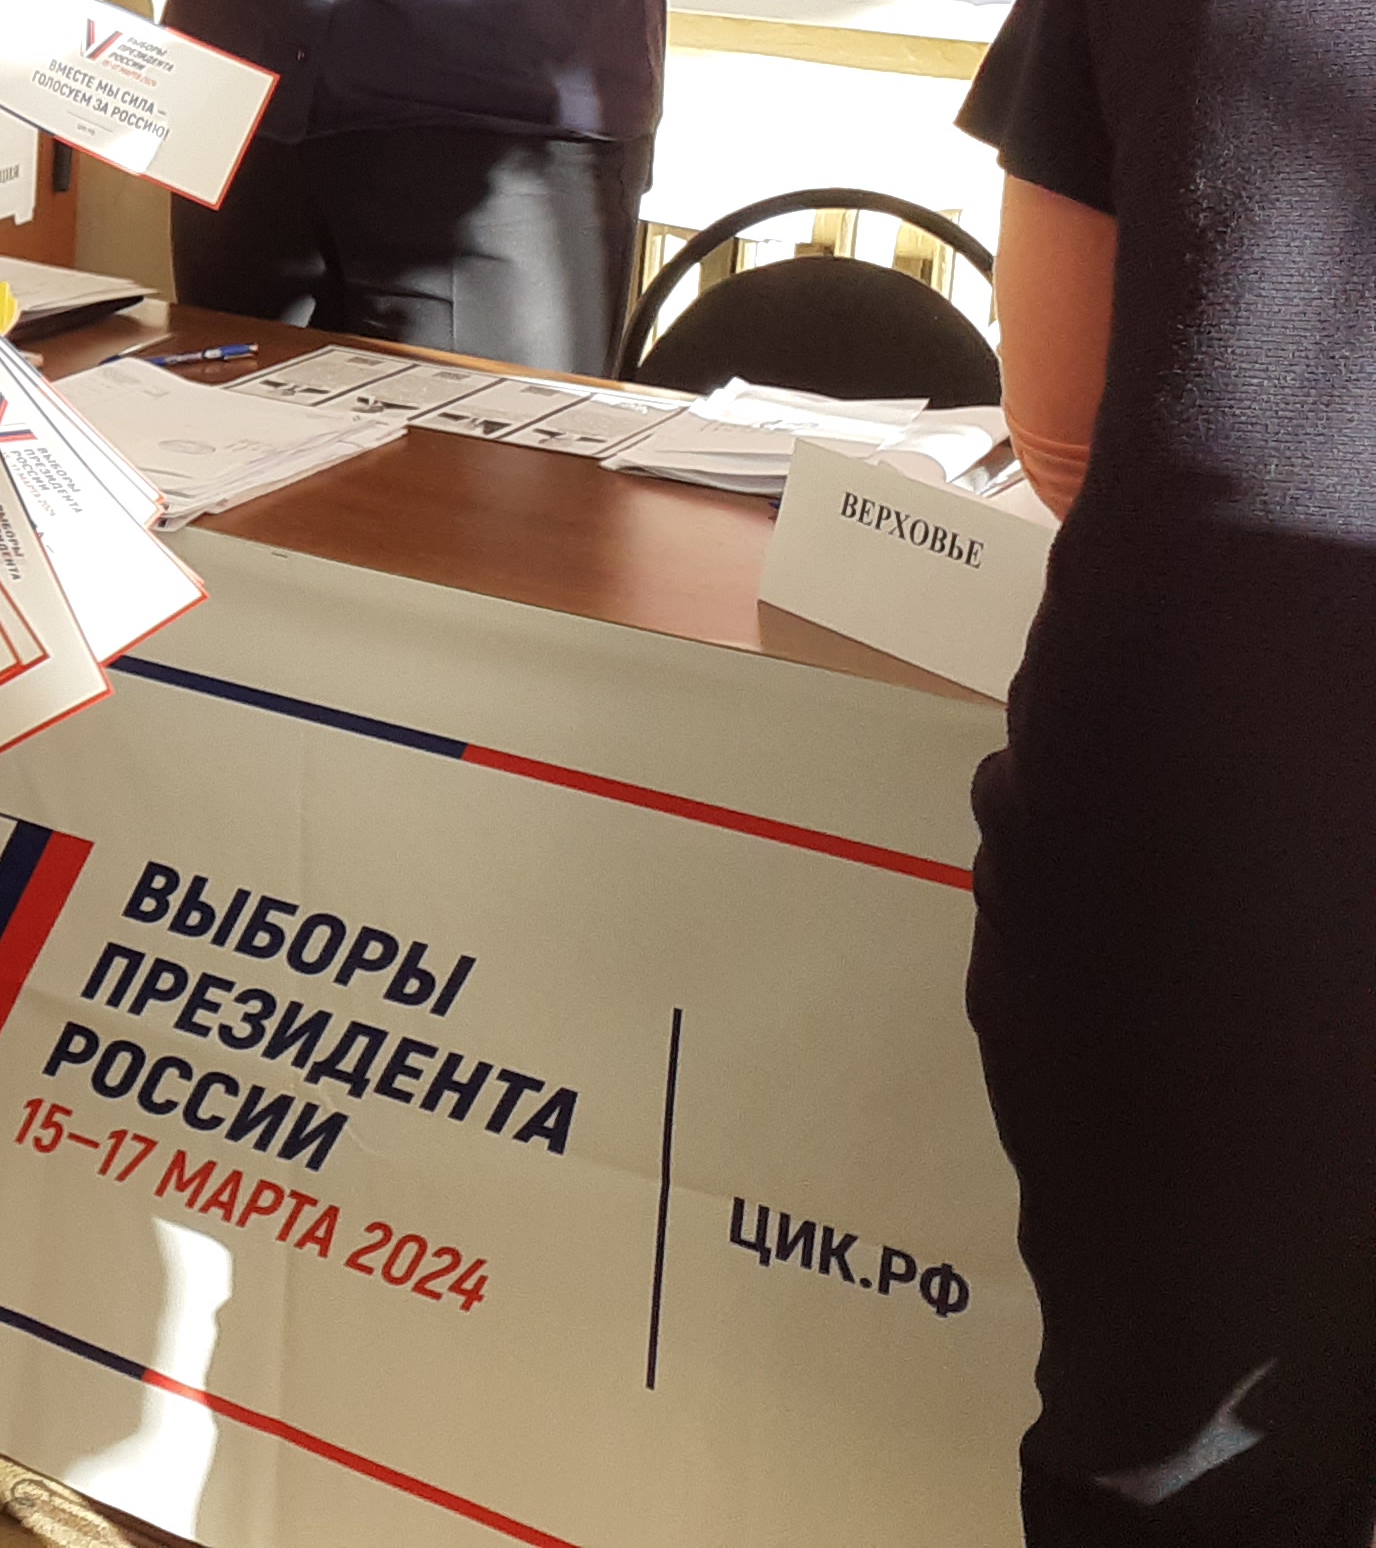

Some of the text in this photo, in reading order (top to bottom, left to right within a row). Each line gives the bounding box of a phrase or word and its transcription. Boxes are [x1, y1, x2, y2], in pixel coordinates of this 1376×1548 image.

[31, 69, 93, 107] ГОЛОСУЕМ
[92, 98, 110, 116] ЗА
[110, 106, 170, 142] РОССИЮ!
[48, 59, 96, 90] ВМЕСТЕ
[95, 79, 121, 100] МЫ
[120, 90, 155, 116] СИЛА
[839, 491, 986, 571] ВЕРХОВЬЕ
[120, 859, 477, 1018] ВЫБОРЫ
[42, 1020, 349, 1173] РОССИИ
[80, 940, 580, 1156] ПРЕЗИДЕНТА
[154, 1147, 342, 1260] МАРТА
[344, 1220, 490, 1313] 2024
[729, 1195, 971, 1319] ЦИК.РФ
